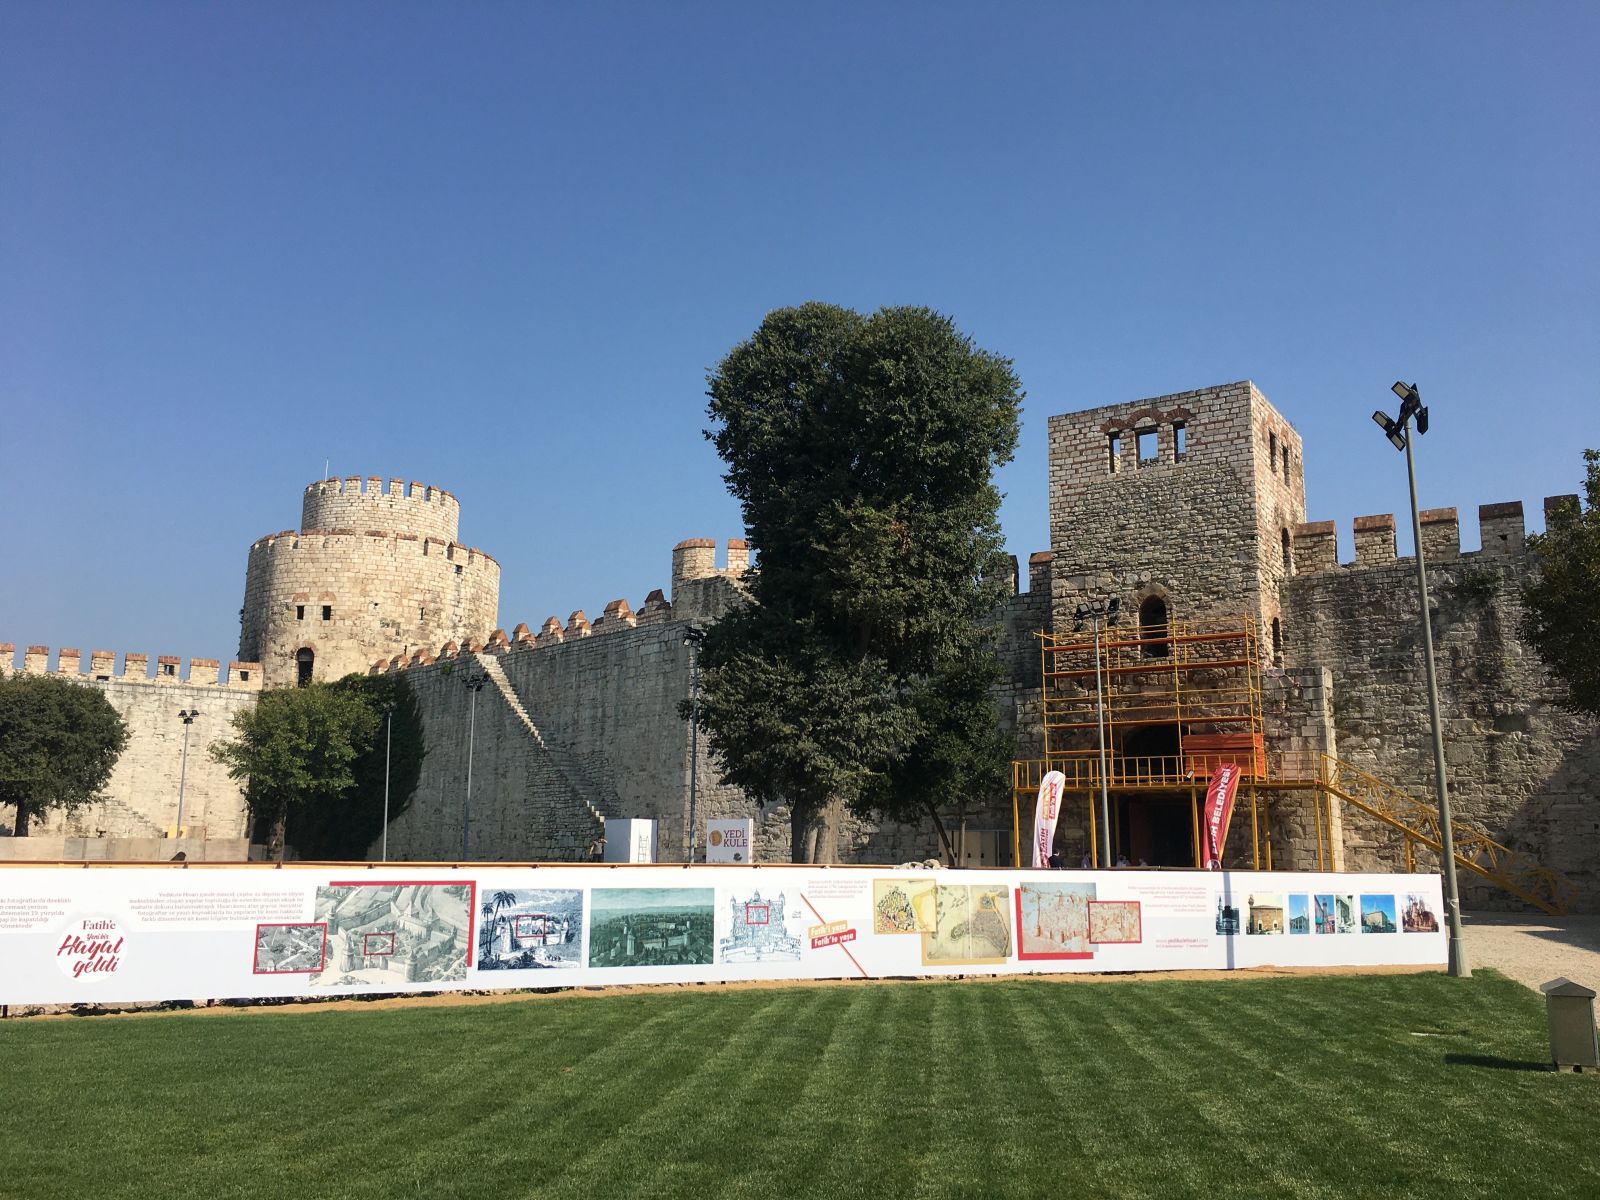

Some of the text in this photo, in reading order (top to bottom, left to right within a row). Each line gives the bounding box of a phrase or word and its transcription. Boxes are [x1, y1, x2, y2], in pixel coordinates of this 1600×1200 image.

[1212, 767, 1231, 824] BELEDİYESİ
[723, 828, 745, 838] YEDİ
[723, 839, 747, 847] KULE
[57, 934, 124, 960] Hayal
[73, 955, 120, 978] geldi
